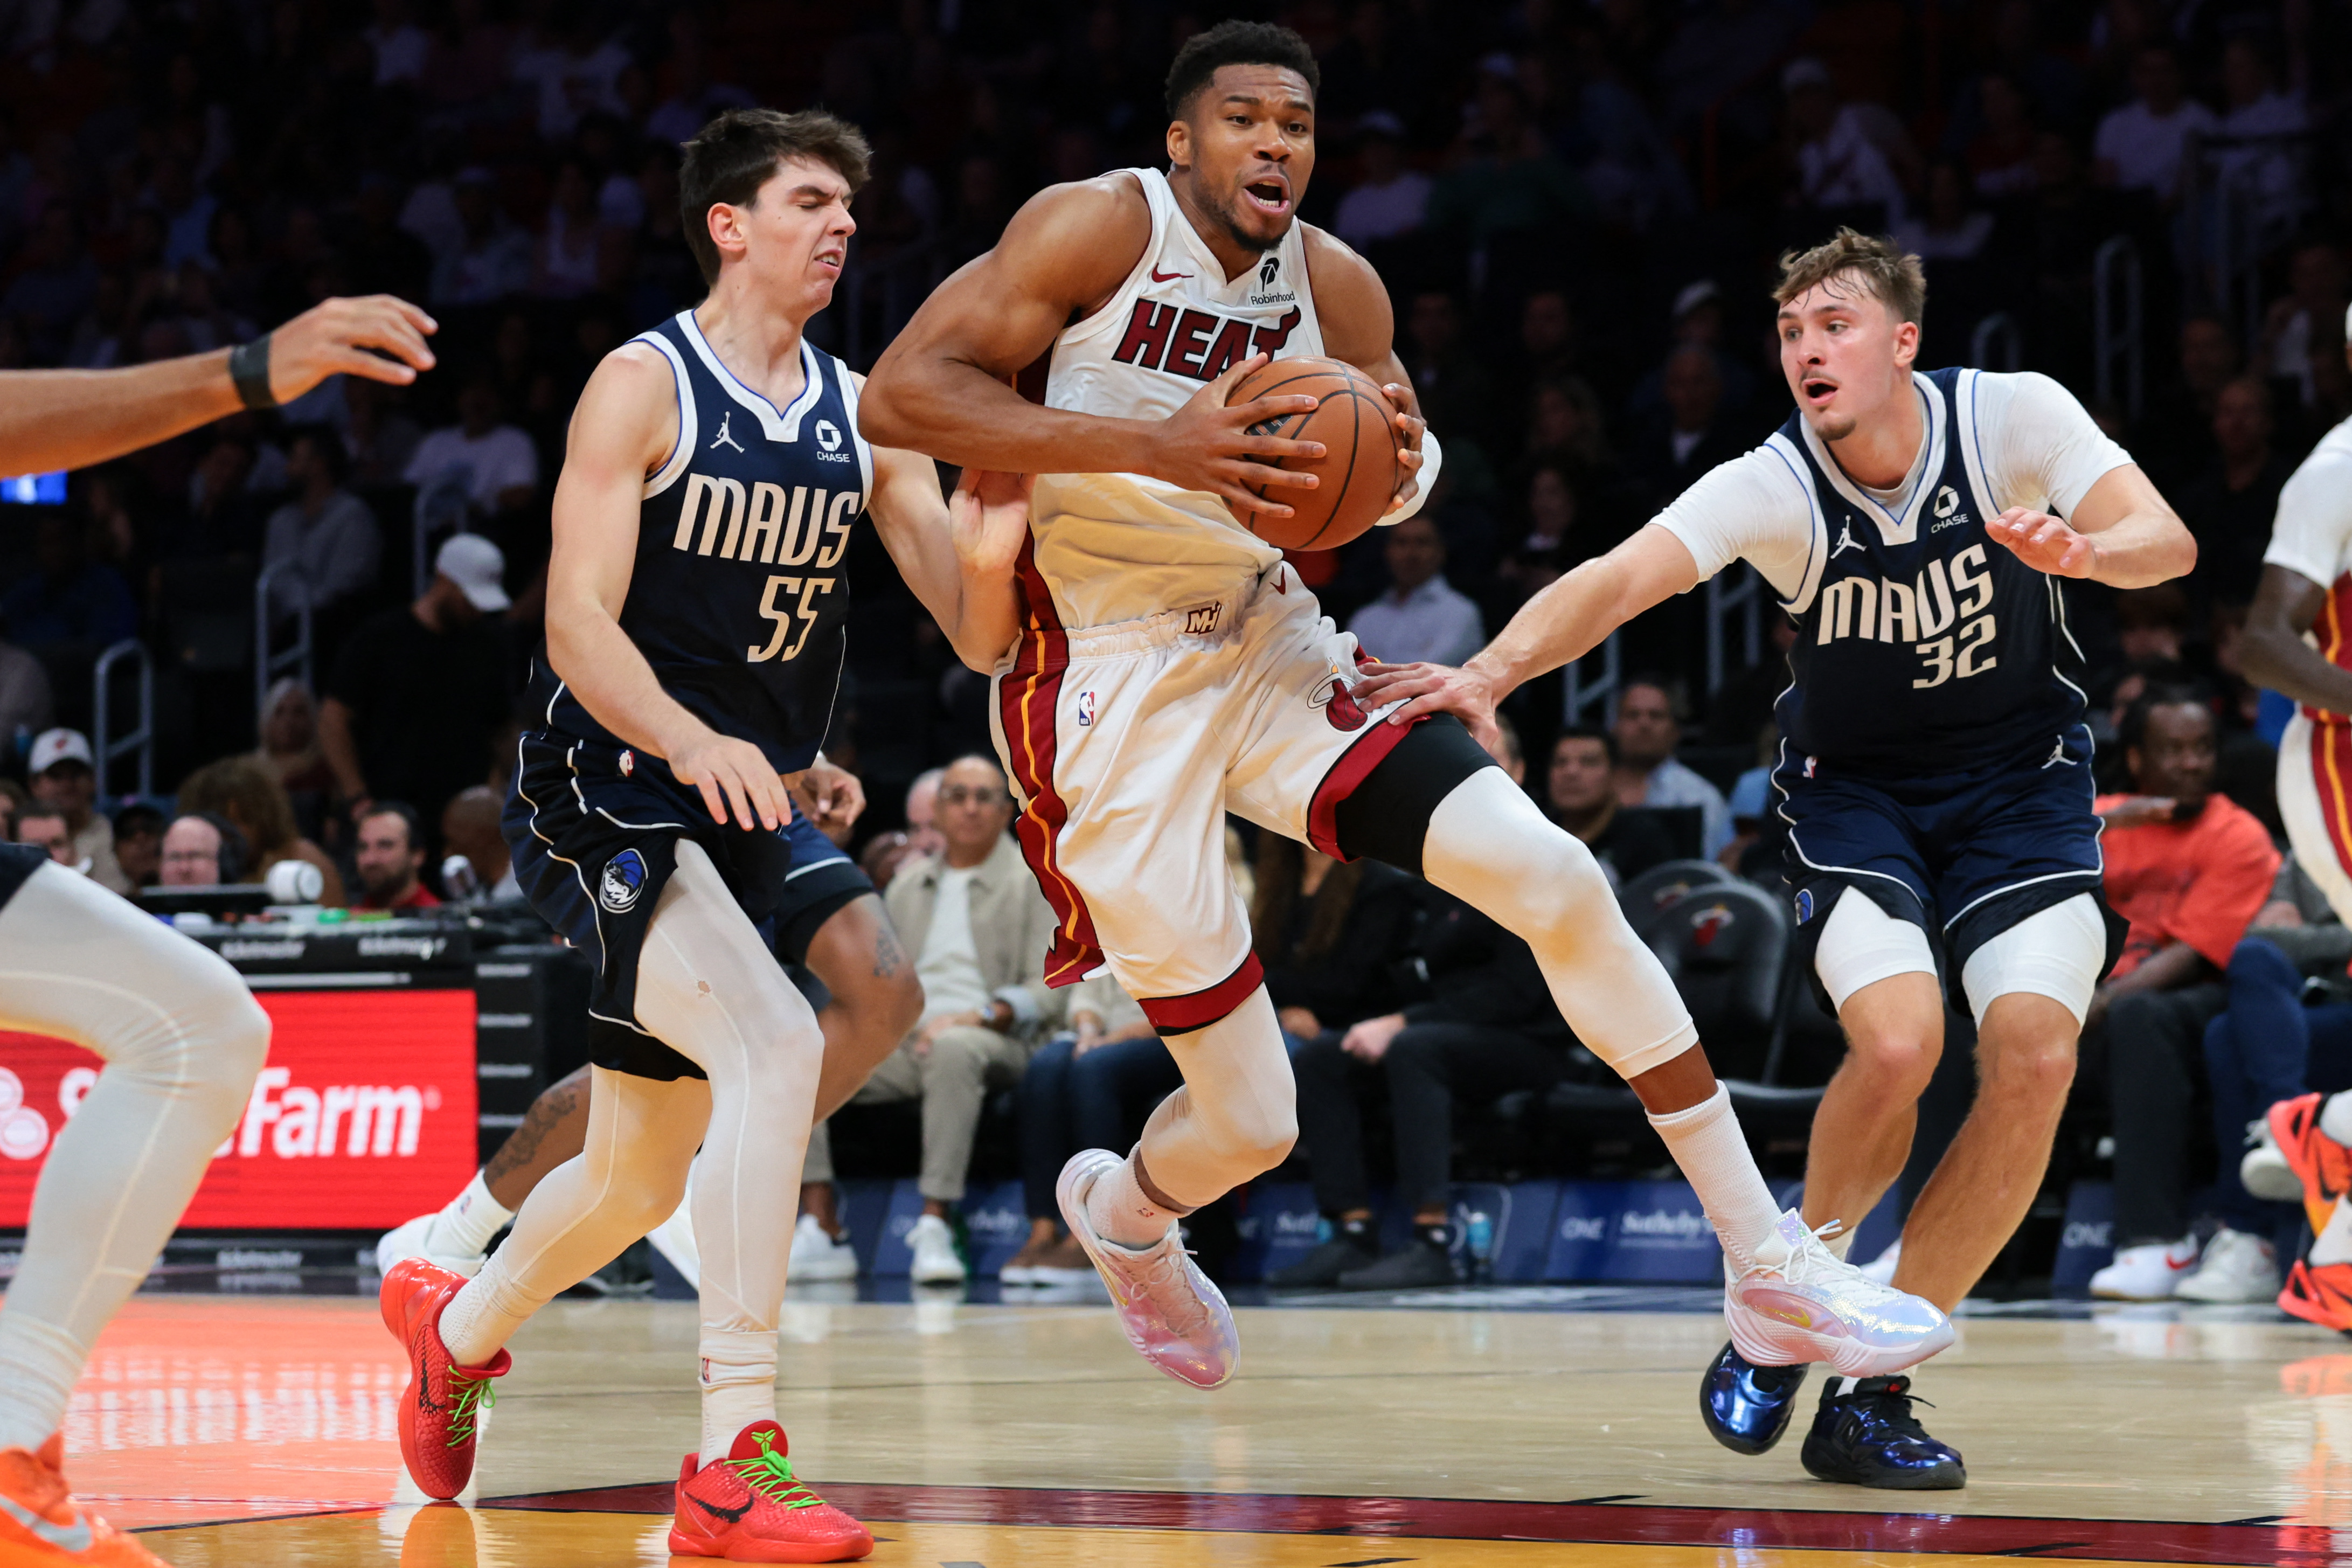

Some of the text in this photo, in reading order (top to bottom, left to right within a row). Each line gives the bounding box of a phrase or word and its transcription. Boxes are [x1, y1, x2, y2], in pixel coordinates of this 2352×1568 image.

[1112, 298, 1301, 383] HEAT
[1251, 291, 1295, 305] Robinhood
[817, 451, 850, 462] CHASE
[672, 473, 859, 568] MAVS
[1931, 514, 1969, 533] CHASE
[747, 574, 836, 663] 55
[1817, 543, 1994, 646] MAVS
[1913, 614, 1997, 689] 32
[238, 1067, 425, 1158] Farm
